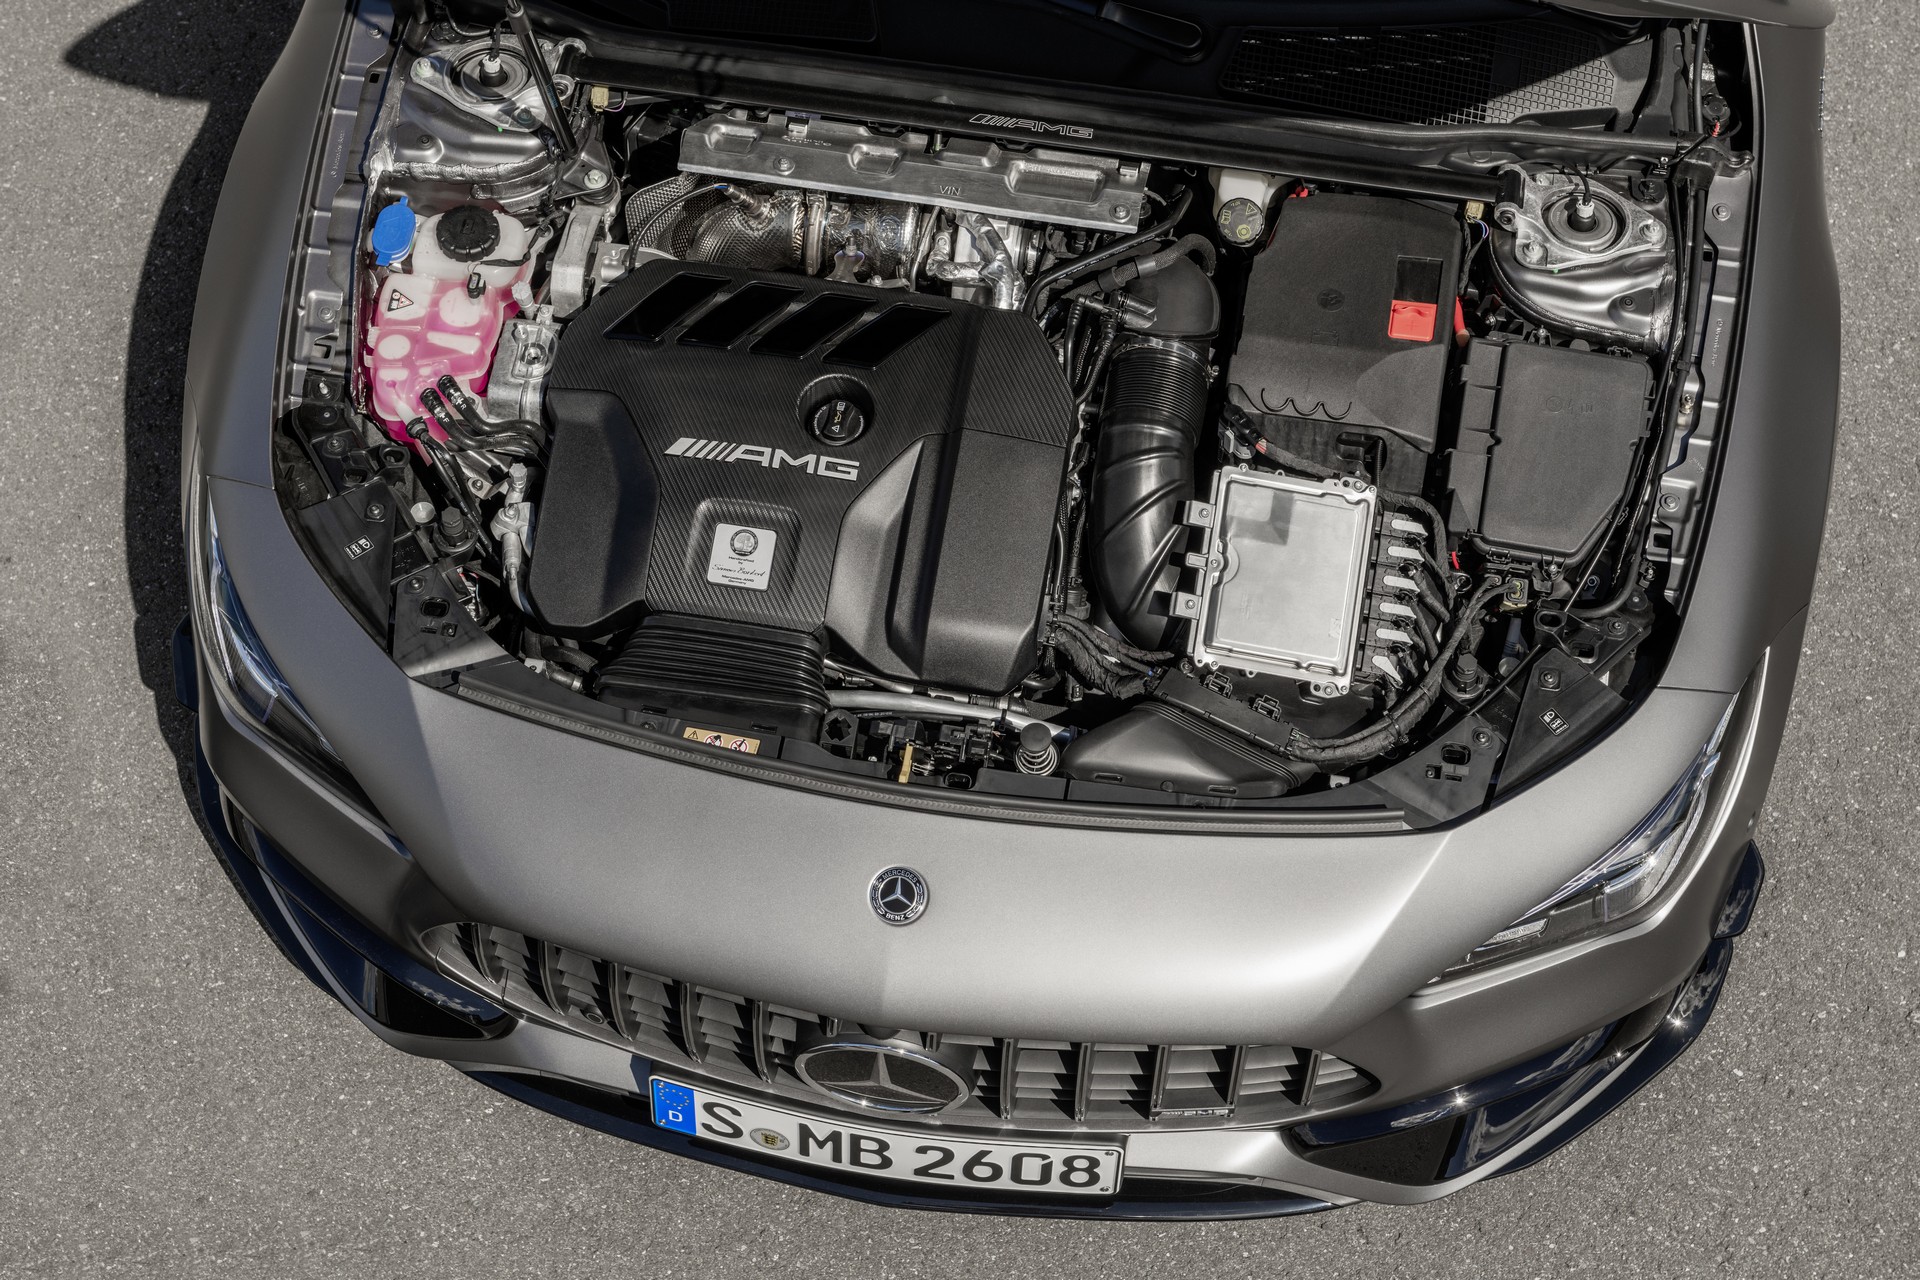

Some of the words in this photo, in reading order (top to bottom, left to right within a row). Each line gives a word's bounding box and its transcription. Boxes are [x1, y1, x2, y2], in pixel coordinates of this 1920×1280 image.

[939, 185, 961, 196] VIN
[724, 443, 860, 482] AMG
[882, 869, 918, 883] MERCEDES
[885, 913, 906, 921] BENZ
[669, 1109, 682, 1123] D
[702, 1101, 744, 1140] S
[799, 1122, 894, 1171] MB
[913, 1145, 1102, 1188] 2608
